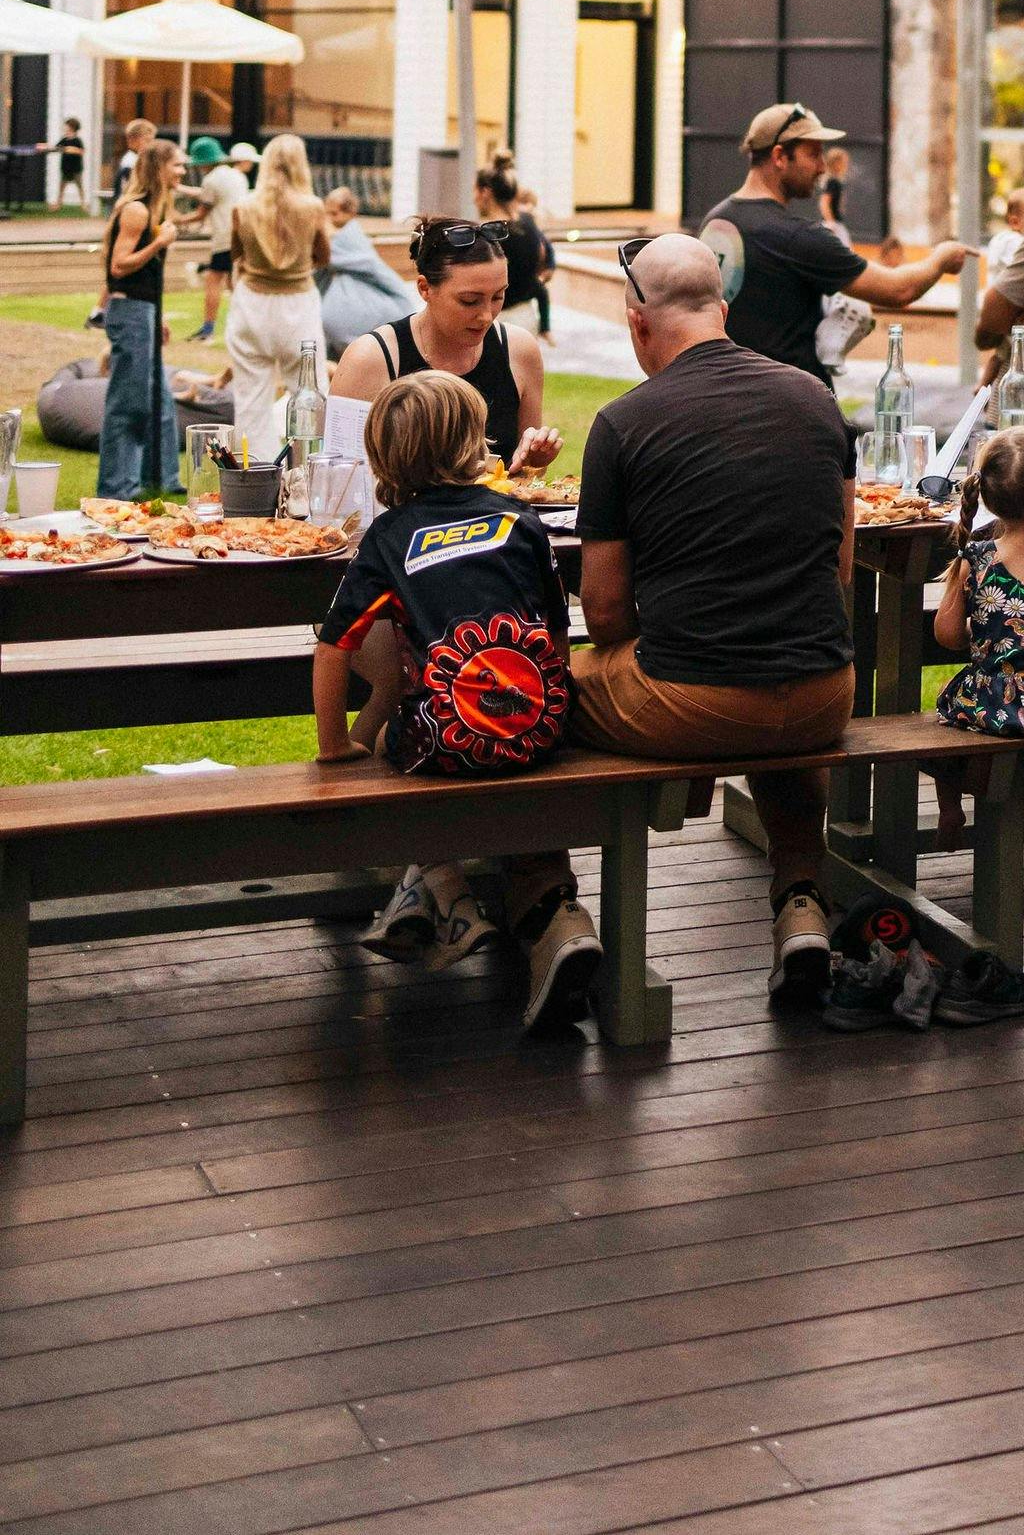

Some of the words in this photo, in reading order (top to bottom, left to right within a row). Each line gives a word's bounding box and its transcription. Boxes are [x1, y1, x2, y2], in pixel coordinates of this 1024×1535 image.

[420, 522, 490, 552] PEP
[406, 559, 430, 571] Express
[430, 548, 461, 562] Transport
[879, 915, 897, 937] S
